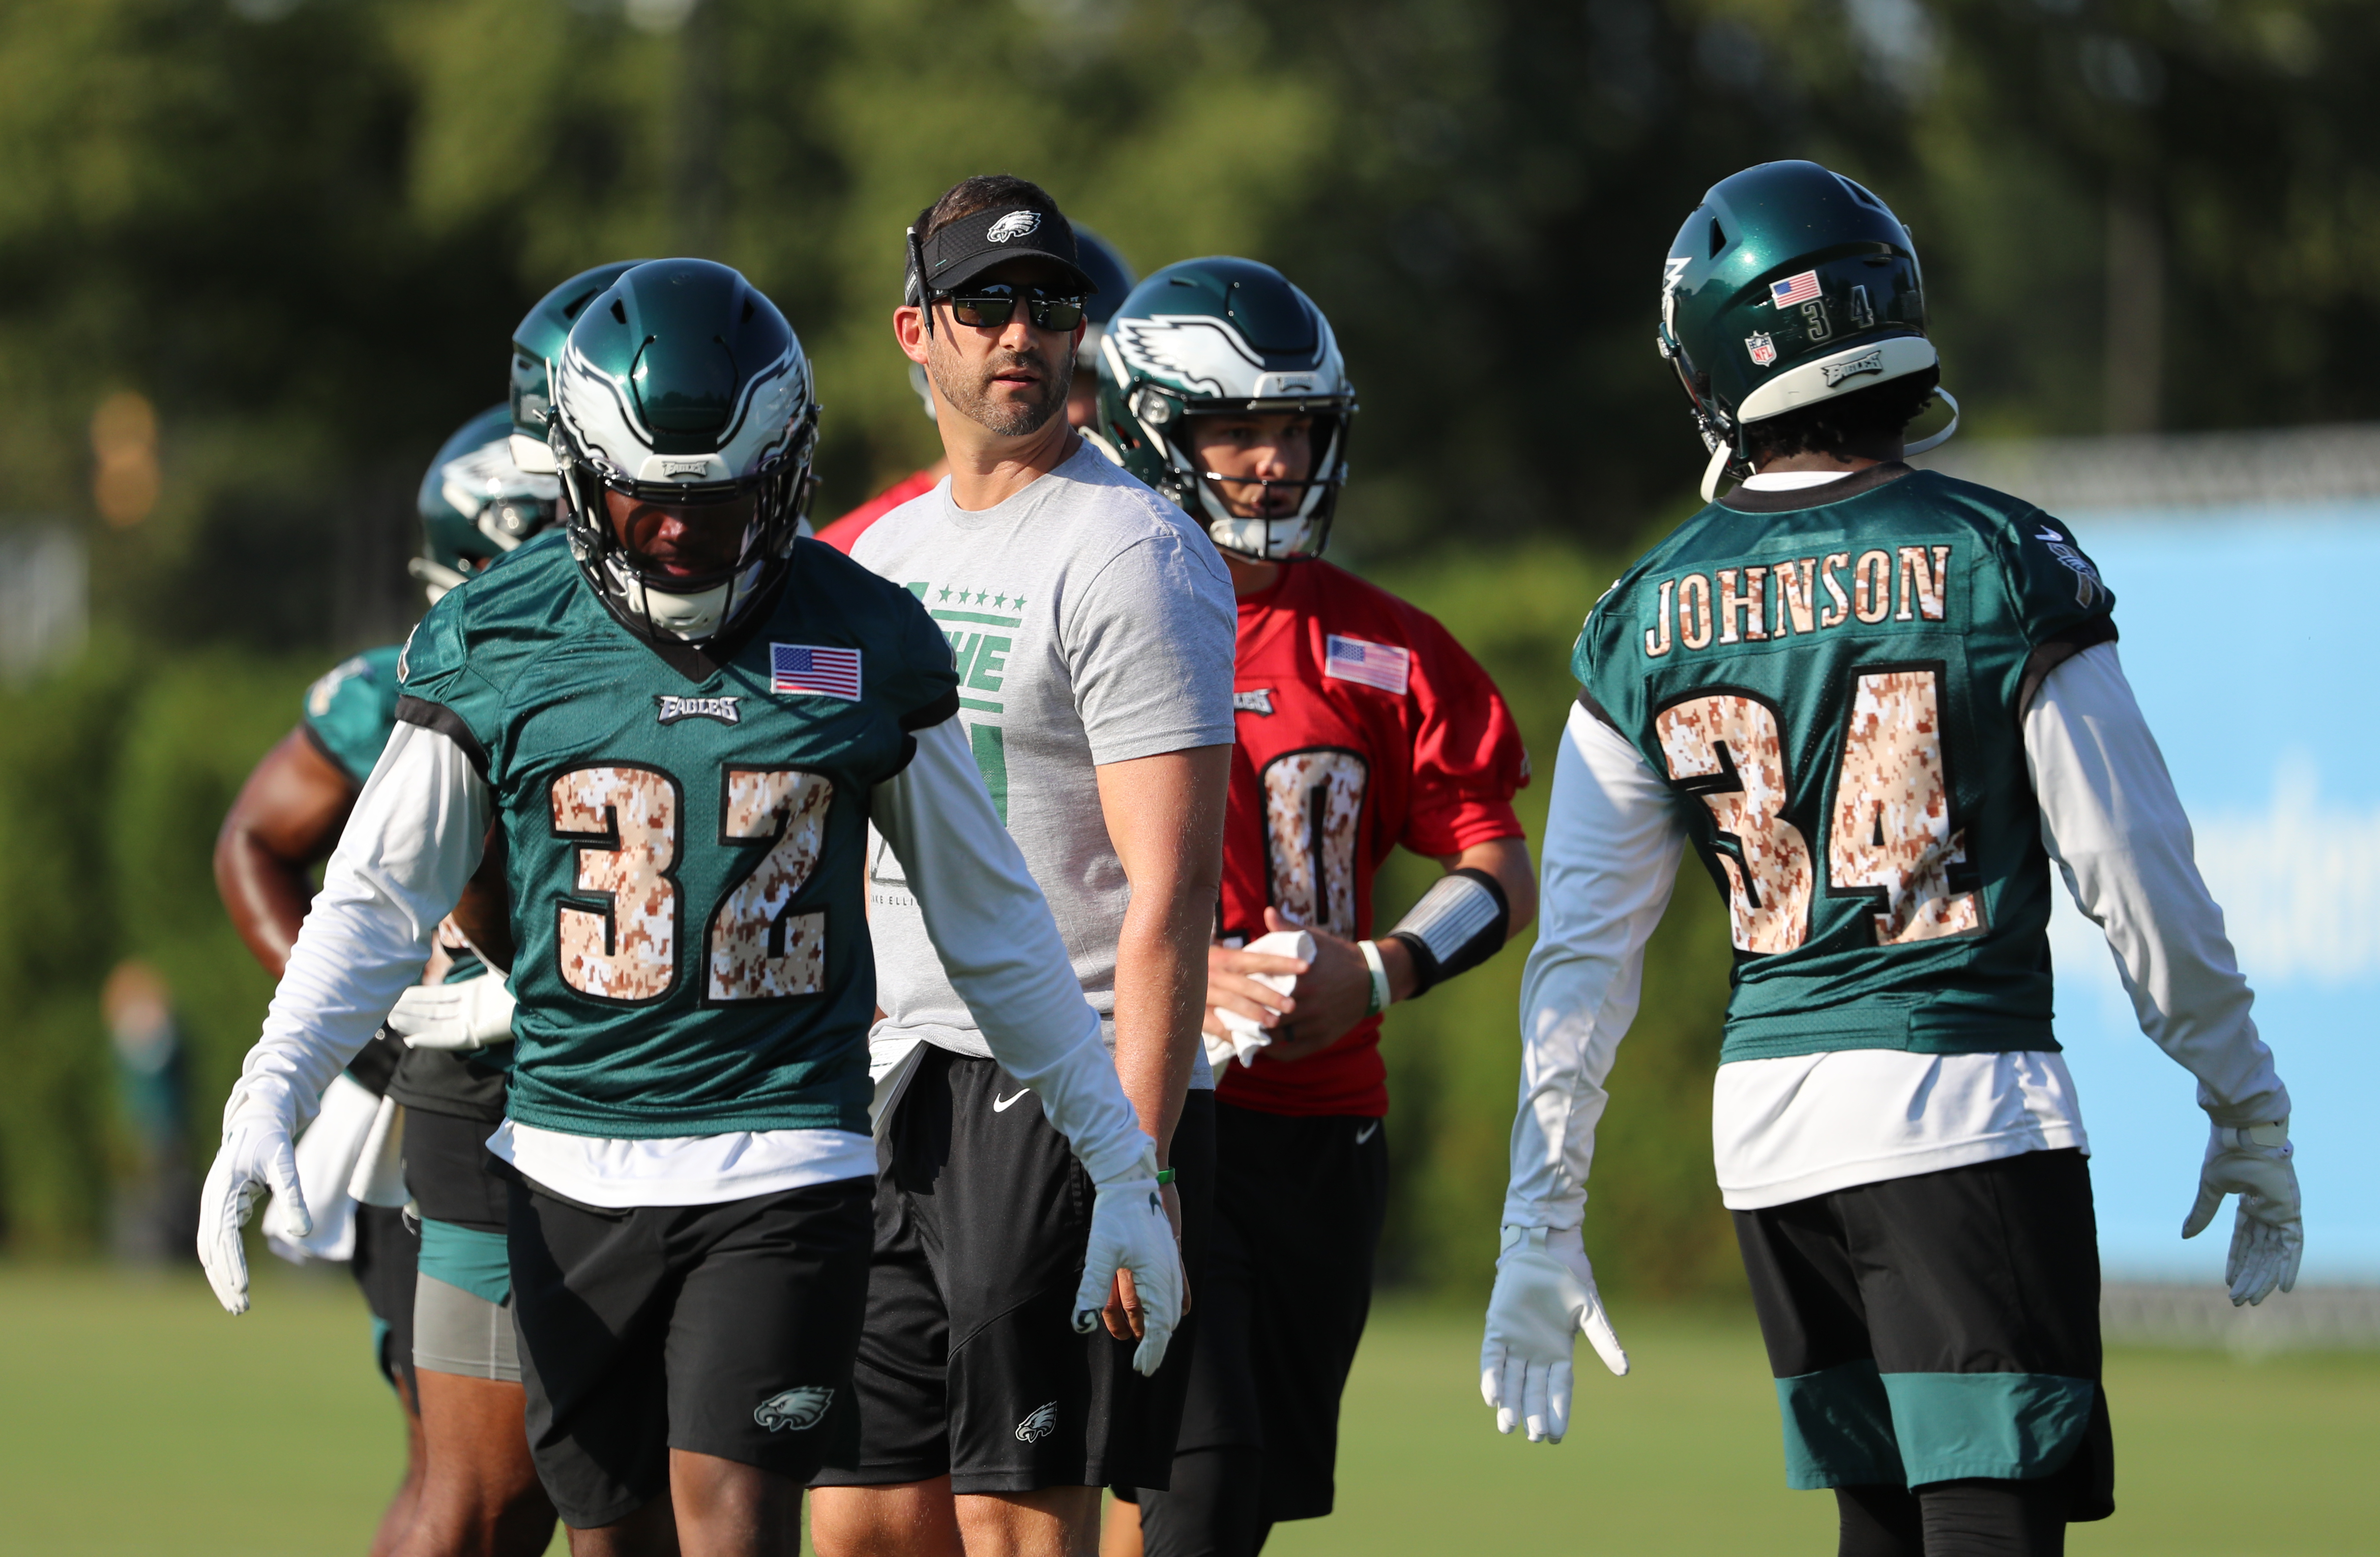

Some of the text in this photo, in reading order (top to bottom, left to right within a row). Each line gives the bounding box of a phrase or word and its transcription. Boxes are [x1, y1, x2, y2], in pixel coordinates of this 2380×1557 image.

[1753, 346, 1774, 361] NFL
[1645, 545, 1952, 658] JOHNSON
[656, 695, 741, 725] EAGLES
[1654, 661, 1988, 955] 34
[547, 760, 835, 1009] 32
